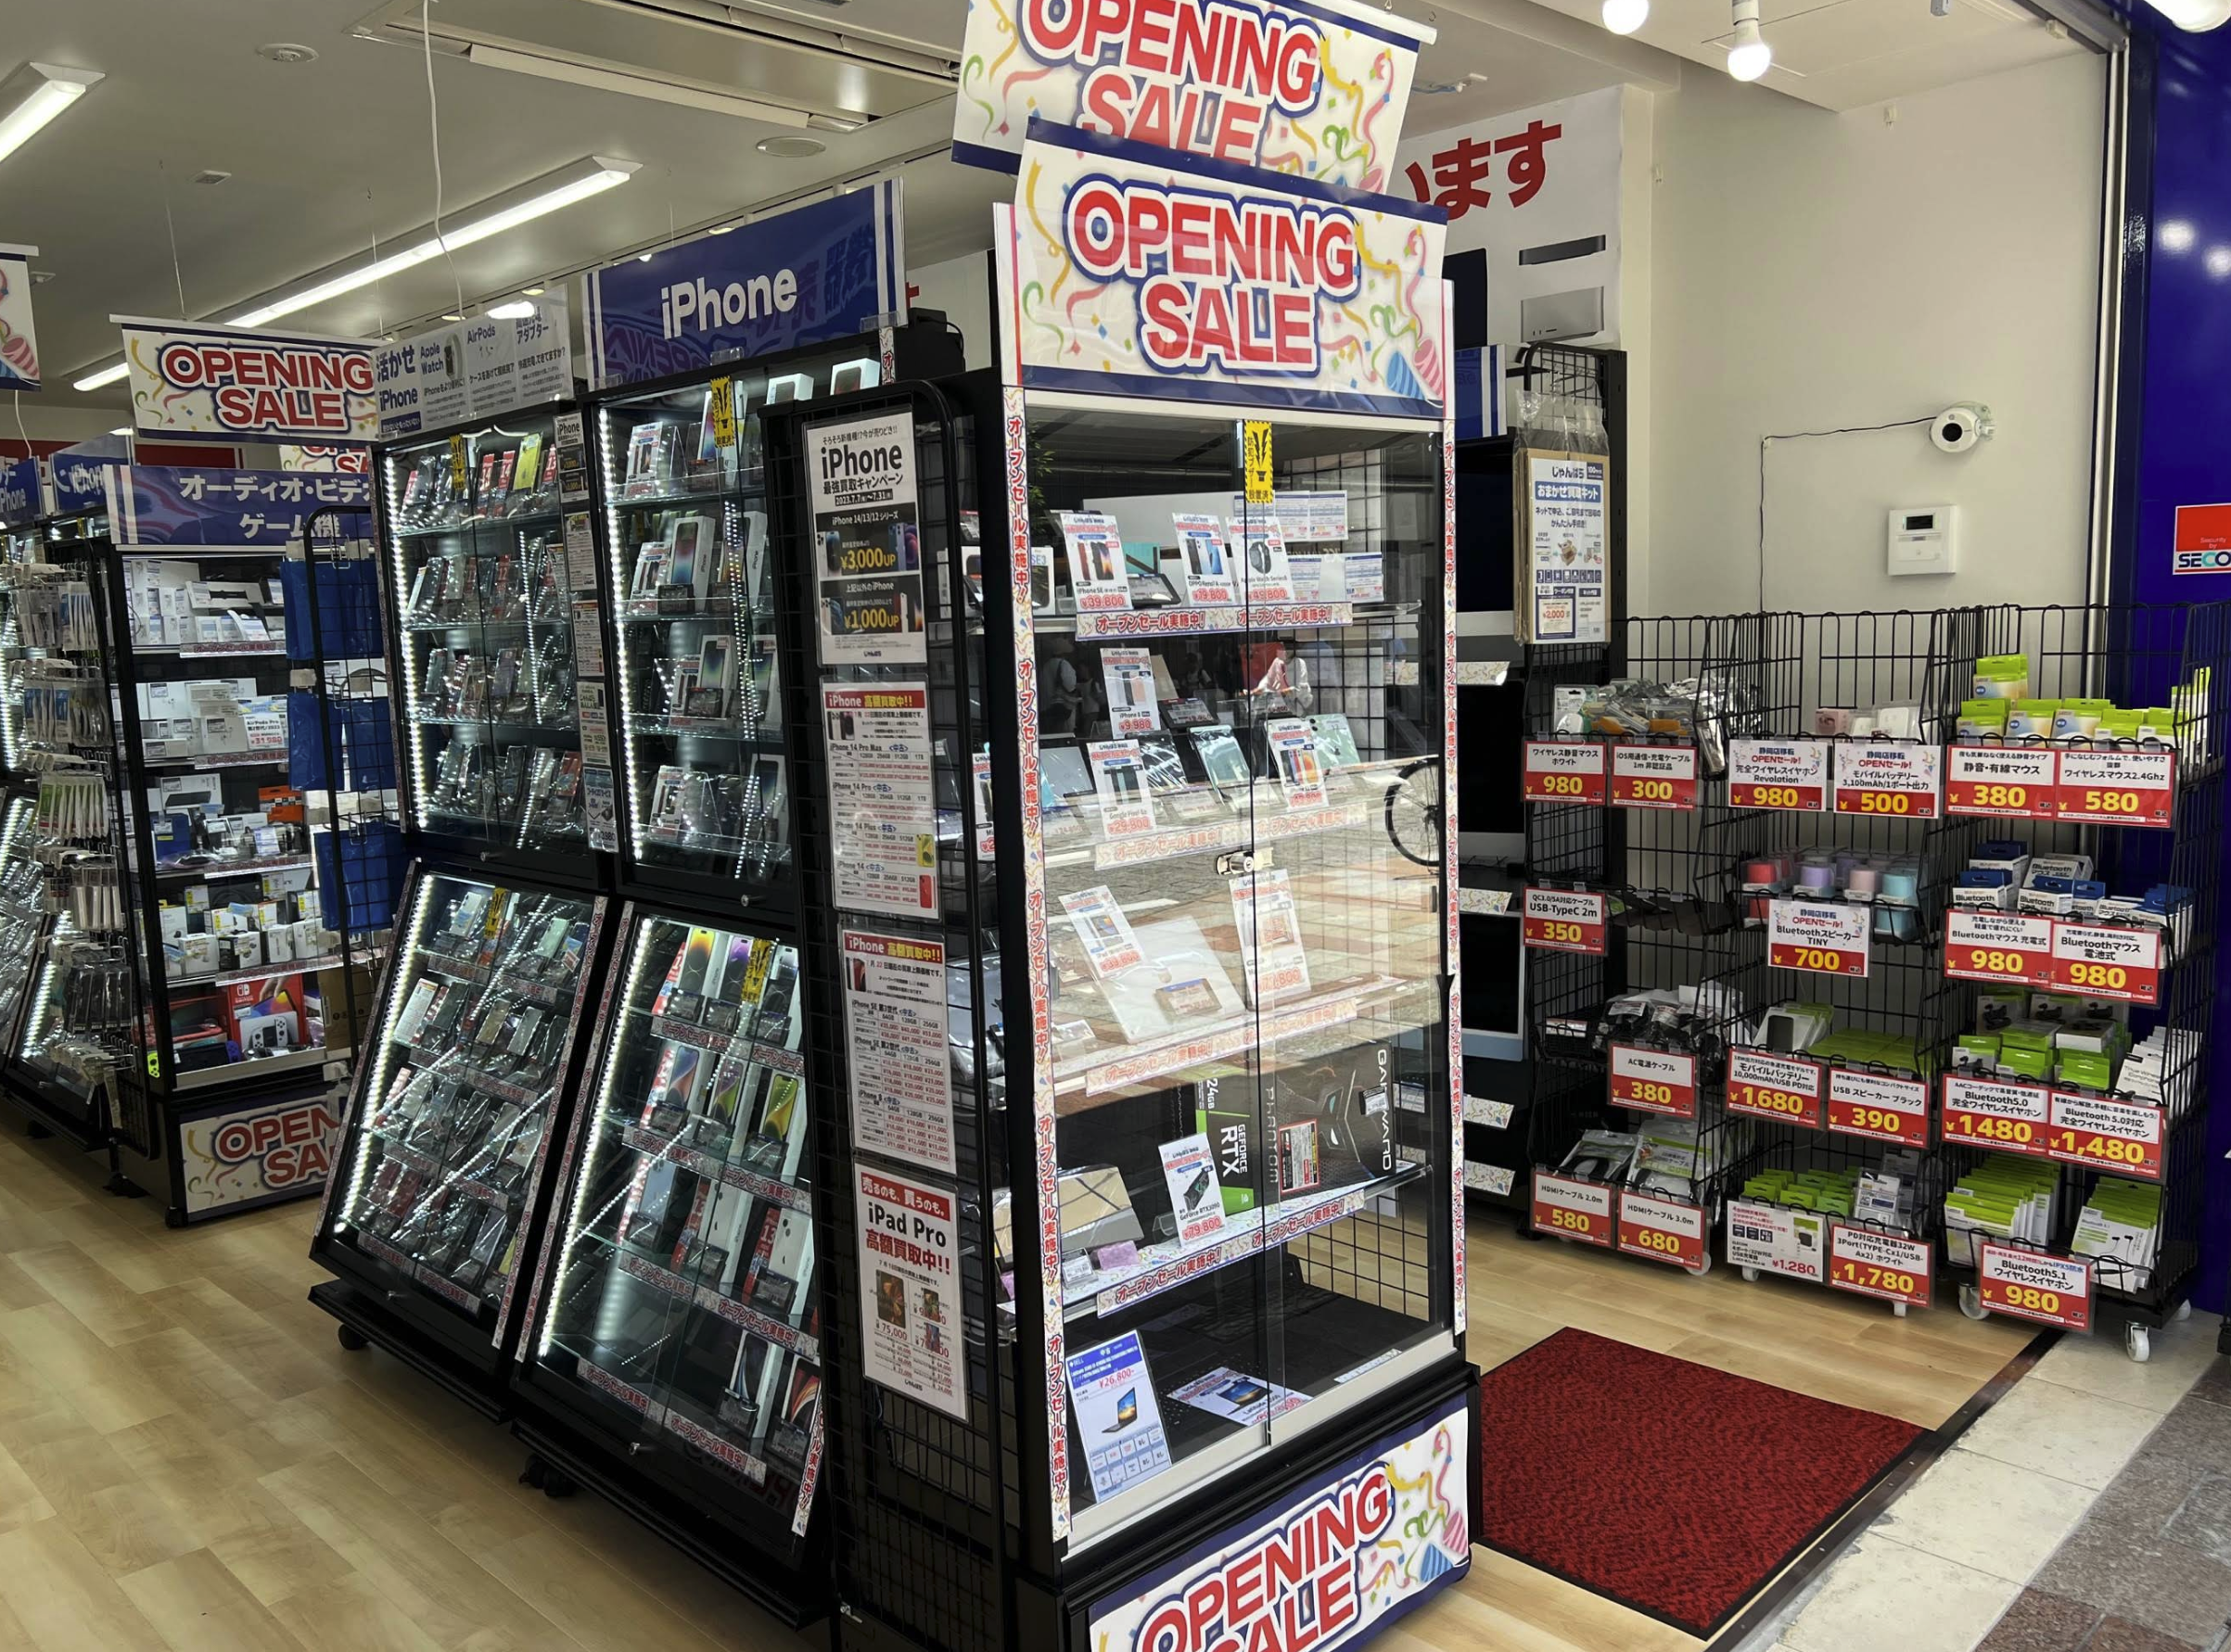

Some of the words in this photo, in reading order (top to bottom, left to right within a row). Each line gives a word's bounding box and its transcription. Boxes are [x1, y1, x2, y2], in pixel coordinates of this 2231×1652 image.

[1026, 0, 1318, 105] OPENING
[1081, 74, 1263, 168] SALE
[1072, 188, 1355, 290] OPENING
[660, 268, 797, 340] iPhone
[467, 324, 496, 344] AirPods
[1143, 282, 1315, 365] SALE
[420, 343, 440, 359] Apple
[163, 347, 375, 393] OPENING
[376, 345, 415, 383] 活かせ
[421, 358, 444, 375] Watch
[219, 388, 344, 430] SALE
[379, 387, 417, 412] iPhone
[821, 444, 902, 480] iPhone
[822, 473, 904, 496] 最強買取キャンペーン
[1248, 489, 1269, 500] 設置済
[832, 515, 853, 527] iPhone
[853, 513, 879, 525] 14/13/12
[1097, 612, 1205, 632] オープンセール実施中!
[1237, 606, 1332, 626] オープンセール実施中!
[828, 695, 862, 708] iPhone
[1532, 747, 1599, 758] ワイヤレス静音マウス
[1552, 757, 1577, 766] ホワイト
[1752, 754, 1801, 765] OPENセール!
[1858, 758, 1912, 769] OPENセール!
[1736, 764, 1818, 776] 完全ワイヤレスイヤホン
[1853, 769, 1919, 781] モバイルバッテリー
[1963, 761, 2041, 775] 静音・有線マウス
[2064, 769, 2165, 782] ワイヤレスマウス2.4Ghz
[1543, 775, 1583, 794] 980
[1632, 780, 1673, 799] 300
[1753, 787, 1799, 807] 980
[1860, 793, 1909, 814] 500
[1973, 785, 2027, 807] 380
[2085, 791, 2139, 813] 580
[1530, 902, 1579, 916] USB-TypeC
[1581, 908, 1598, 918] 2m
[1543, 921, 1582, 943] 350
[1777, 925, 1860, 941] Bluetoothスピーカー
[1807, 936, 1829, 947] TINY
[1952, 930, 2018, 943] Bluetoothマウス
[2021, 936, 2046, 947] 充電式
[848, 934, 885, 954] iPhone
[2061, 936, 2141, 953] Bluetoothマウス
[2084, 948, 2116, 961] 電池式
[1794, 947, 1840, 971] 700
[1970, 949, 2023, 972] 980
[2070, 963, 2126, 989] 980
[1740, 1062, 1810, 1082] モバイルバッテリー
[1206, 1078, 1218, 1110] 24GB
[1631, 1081, 1672, 1104] 380
[1742, 1087, 1804, 1114] 1,680
[1833, 1086, 1851, 1095] USB
[1853, 1088, 1890, 1100] スピーカー
[1893, 1095, 1922, 1107] ブラック
[1965, 1090, 2028, 1107] Bluetooth5.0
[1952, 1099, 2042, 1118] 完全ワイヤレスイヤホン
[2065, 1107, 2110, 1122] Bluetooth
[2111, 1115, 2145, 1128] 5.0対応
[1852, 1108, 1900, 1132] 390
[1959, 1114, 2032, 1143] 1,480
[2059, 1116, 2150, 1138] 完全ワイヤレスイヤホン
[1220, 1125, 1241, 1178] RTX
[1238, 1124, 1248, 1174] GEFORCE
[2061, 1131, 2145, 1164] 1,480
[266, 1144, 335, 1184] SA
[1541, 1184, 1584, 1200] HDMIケーブル
[1585, 1193, 1603, 1204] 2.0m
[868, 1202, 907, 1235] iPad
[913, 1216, 947, 1248] Pro
[1253, 1201, 1345, 1248] オープンセール実施中!
[1551, 1208, 1590, 1233] 580
[1627, 1204, 1675, 1221] HDMIケーブル
[1675, 1215, 1695, 1226] 3.0m
[1638, 1229, 1680, 1254] 680
[1875, 1254, 1905, 1267] ホワイト
[2001, 1259, 2066, 1281] Bluetooth5.1
[1116, 1247, 1222, 1304] オープンセール実施中!
[1843, 1263, 1914, 1294] 1,780
[1994, 1267, 2074, 1290] ワイヤレスイヤホン
[2006, 1285, 2059, 1314] 980
[1141, 1472, 1387, 1652] OPENING
[1206, 1560, 1356, 1652] ALE
